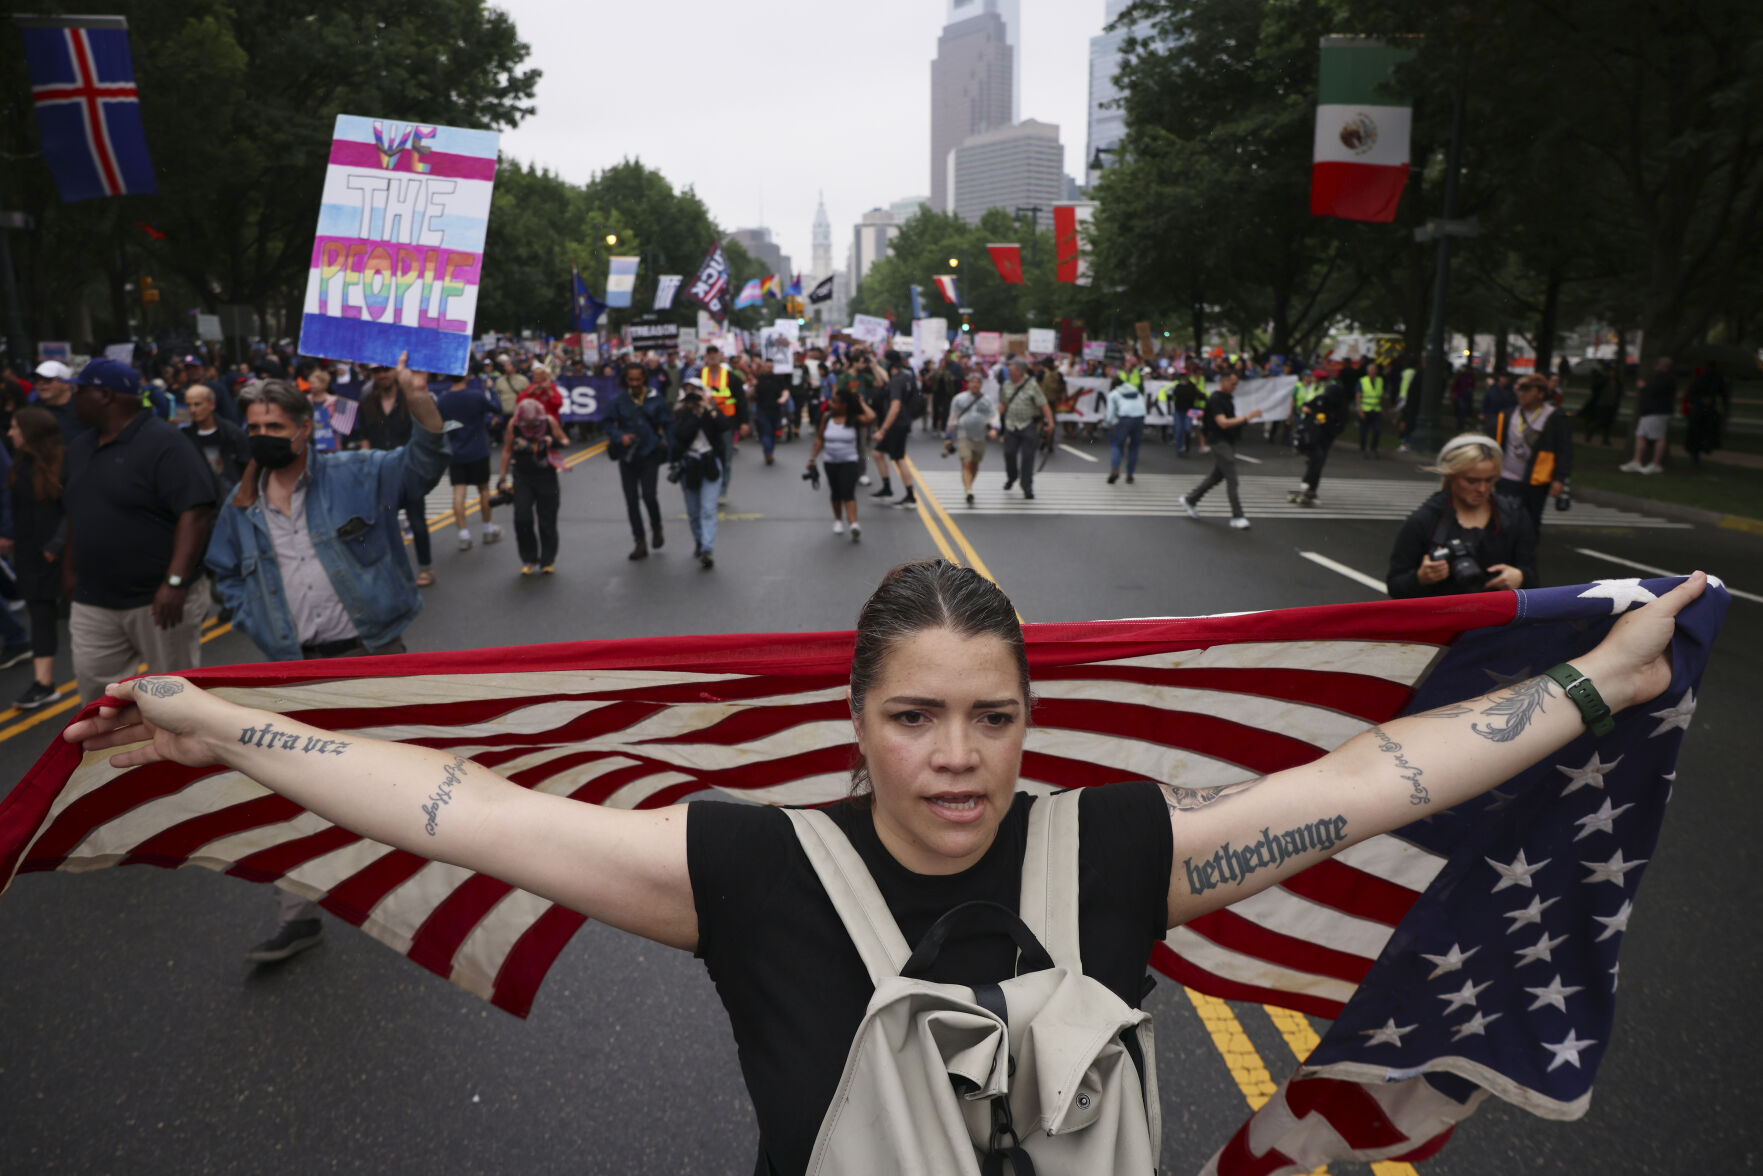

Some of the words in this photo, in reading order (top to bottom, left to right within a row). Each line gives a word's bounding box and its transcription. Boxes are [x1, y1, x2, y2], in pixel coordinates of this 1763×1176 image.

[373, 120, 437, 173] WE
[346, 174, 458, 247] THE
[318, 240, 476, 333] PEOPLE
[237, 722, 301, 751] otra
[301, 735, 354, 756] vez
[1182, 814, 1348, 896] bethechange
